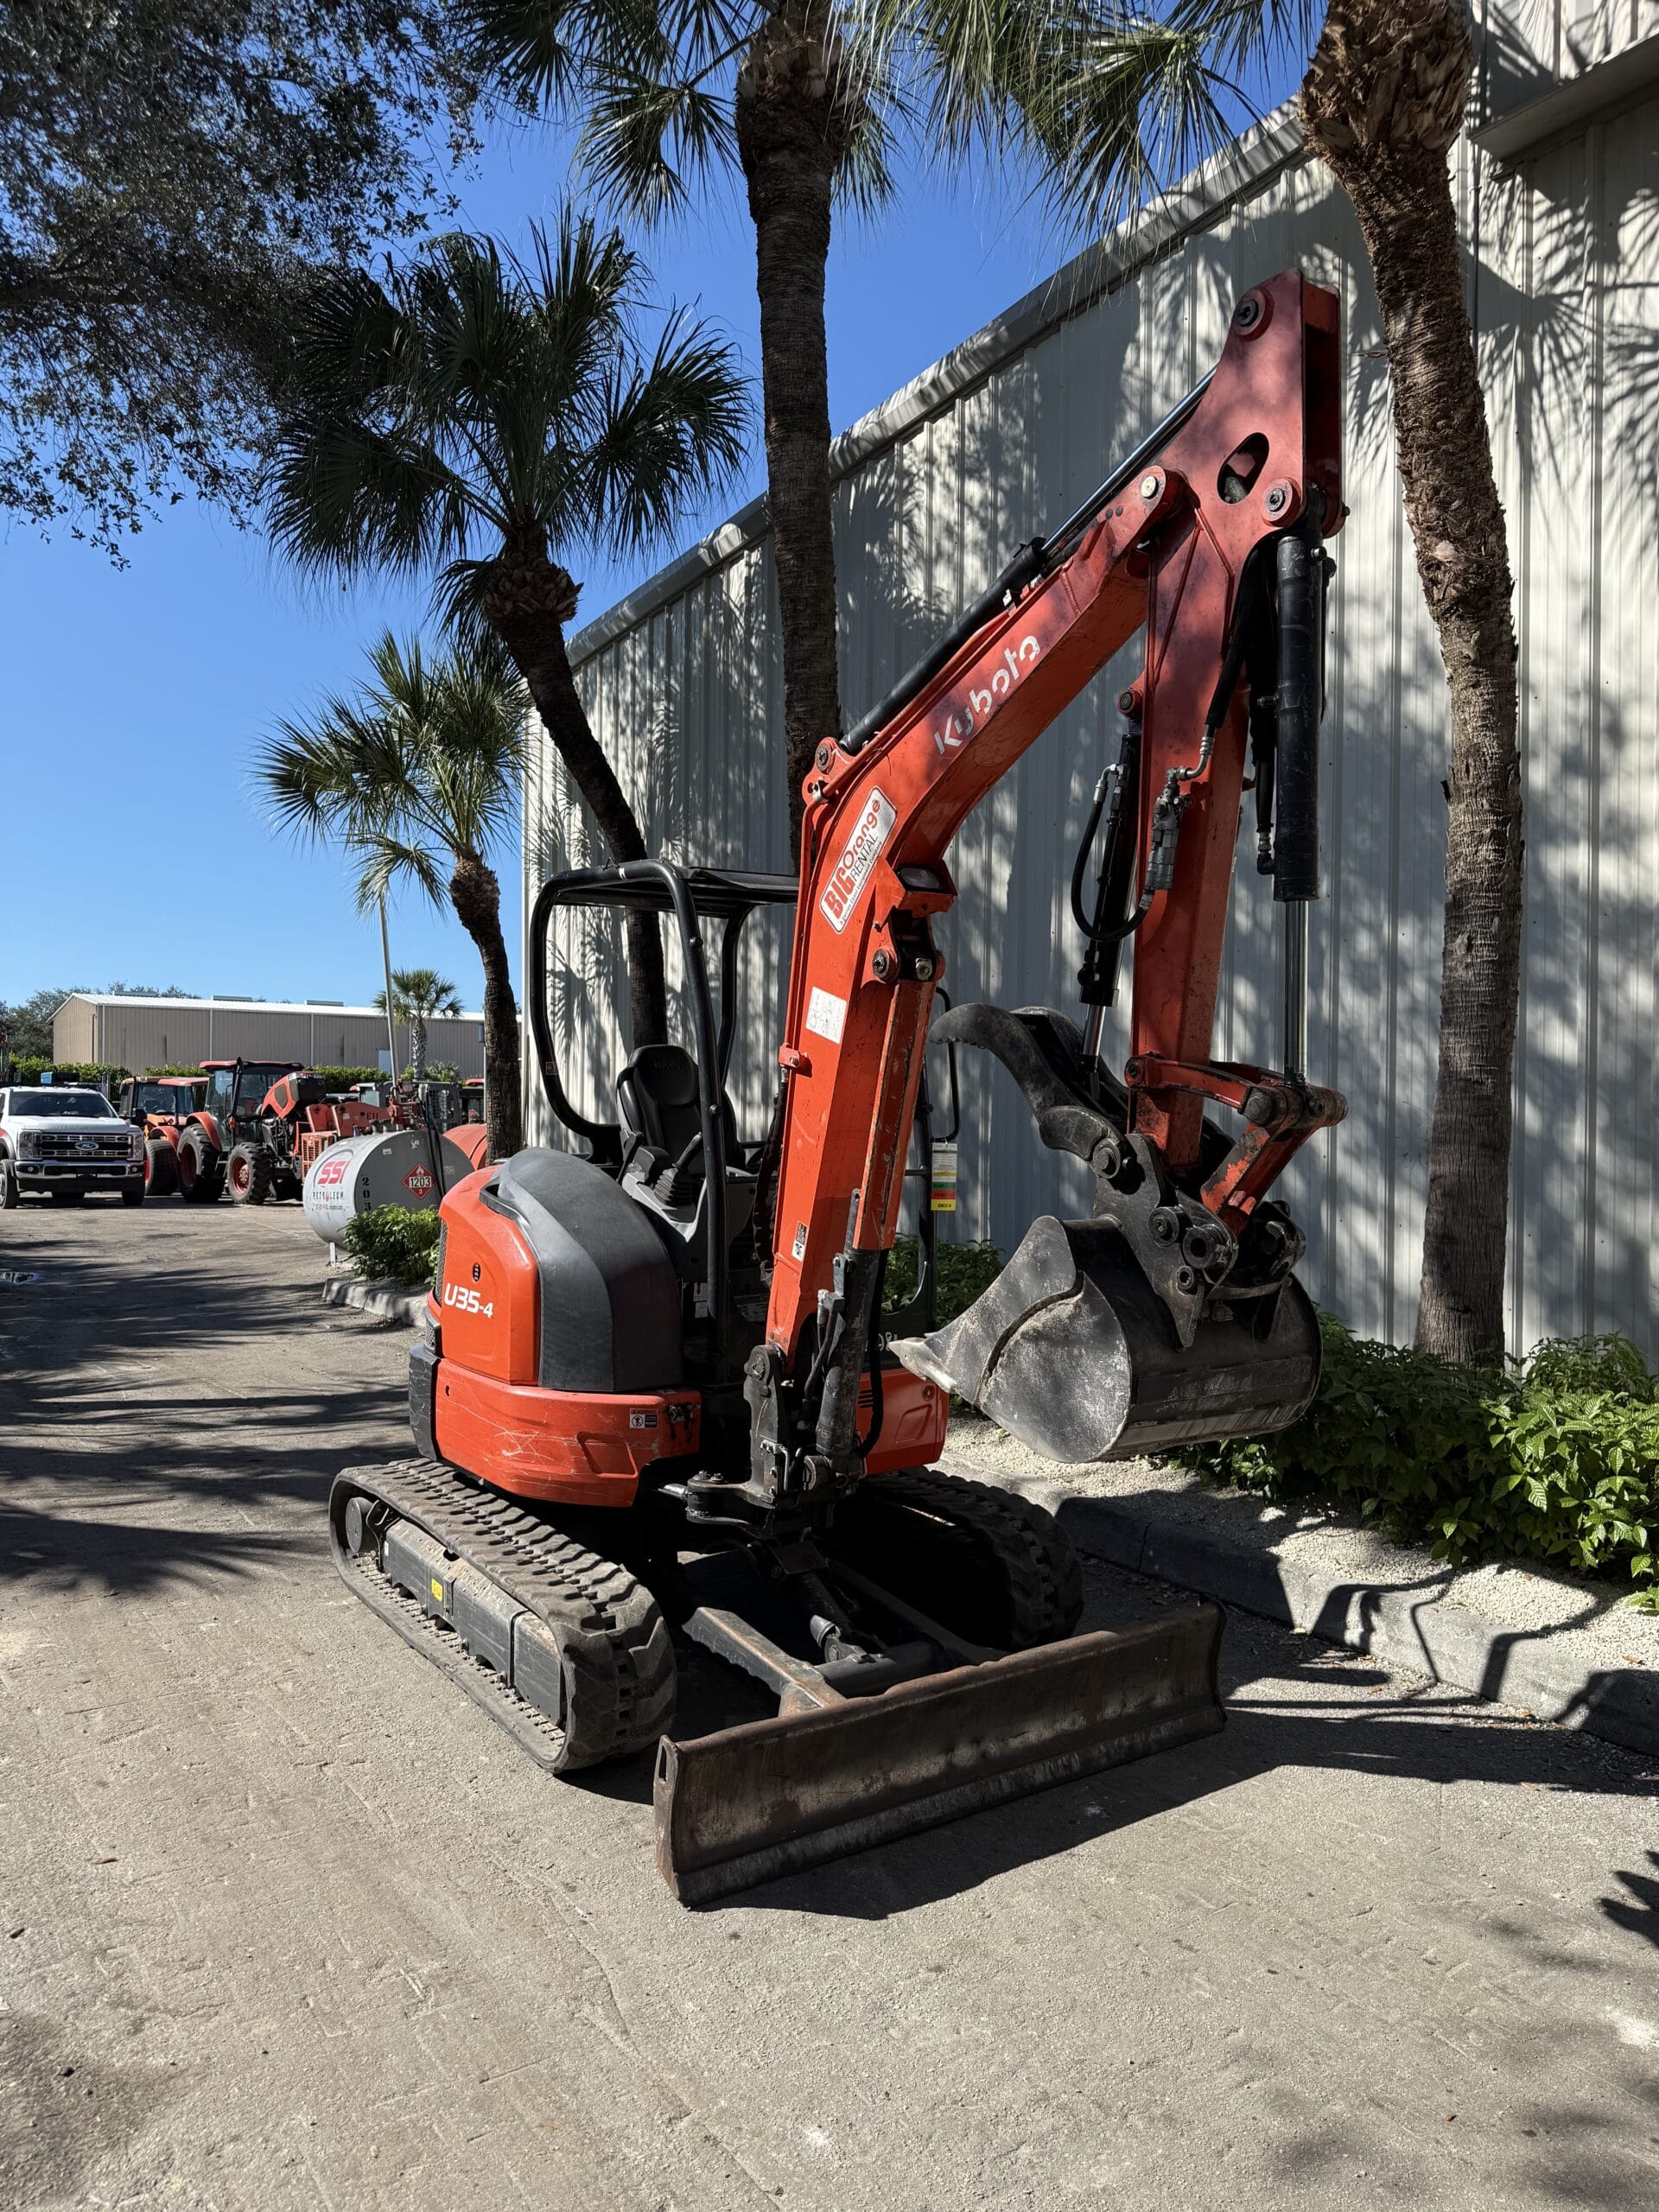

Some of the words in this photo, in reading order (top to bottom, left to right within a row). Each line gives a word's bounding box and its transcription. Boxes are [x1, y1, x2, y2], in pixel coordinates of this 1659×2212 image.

[934, 635, 1040, 755] Kubota
[823, 866, 855, 919] BIG
[842, 800, 880, 867] Orange
[849, 834, 879, 882] RENTAL
[318, 1160, 350, 1184] SSI
[410, 1177, 430, 1187] 1203
[444, 1282, 493, 1319] U35-4
